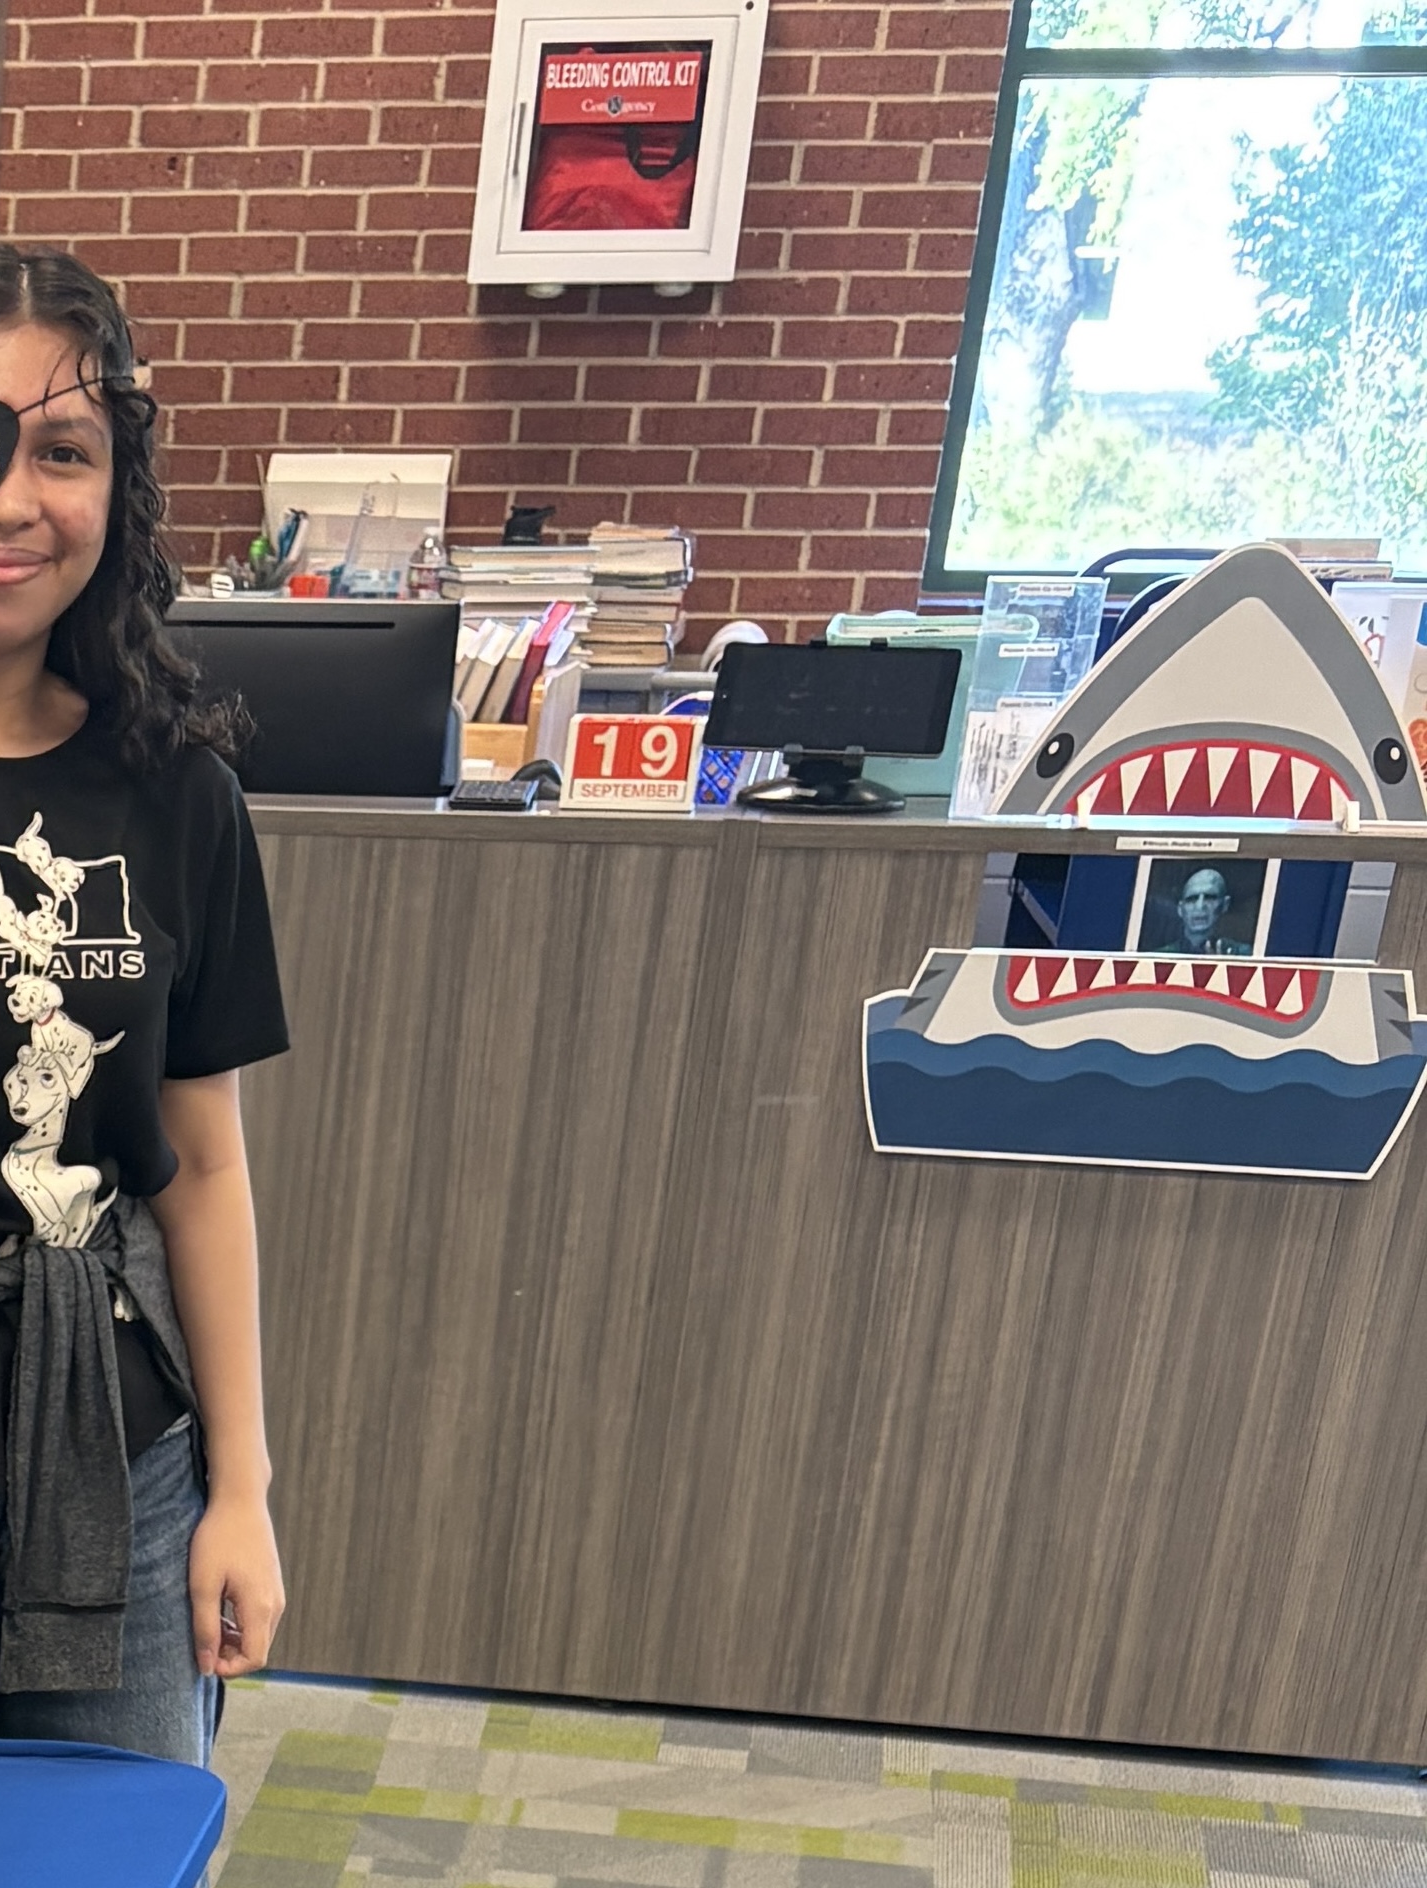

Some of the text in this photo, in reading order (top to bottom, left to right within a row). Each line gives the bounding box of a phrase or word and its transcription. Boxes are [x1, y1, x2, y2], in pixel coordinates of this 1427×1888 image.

[547, 60, 699, 89] BLEEDING CONTROL KIT
[593, 725, 678, 779] 19
[580, 782, 679, 798] SEPTEMBER
